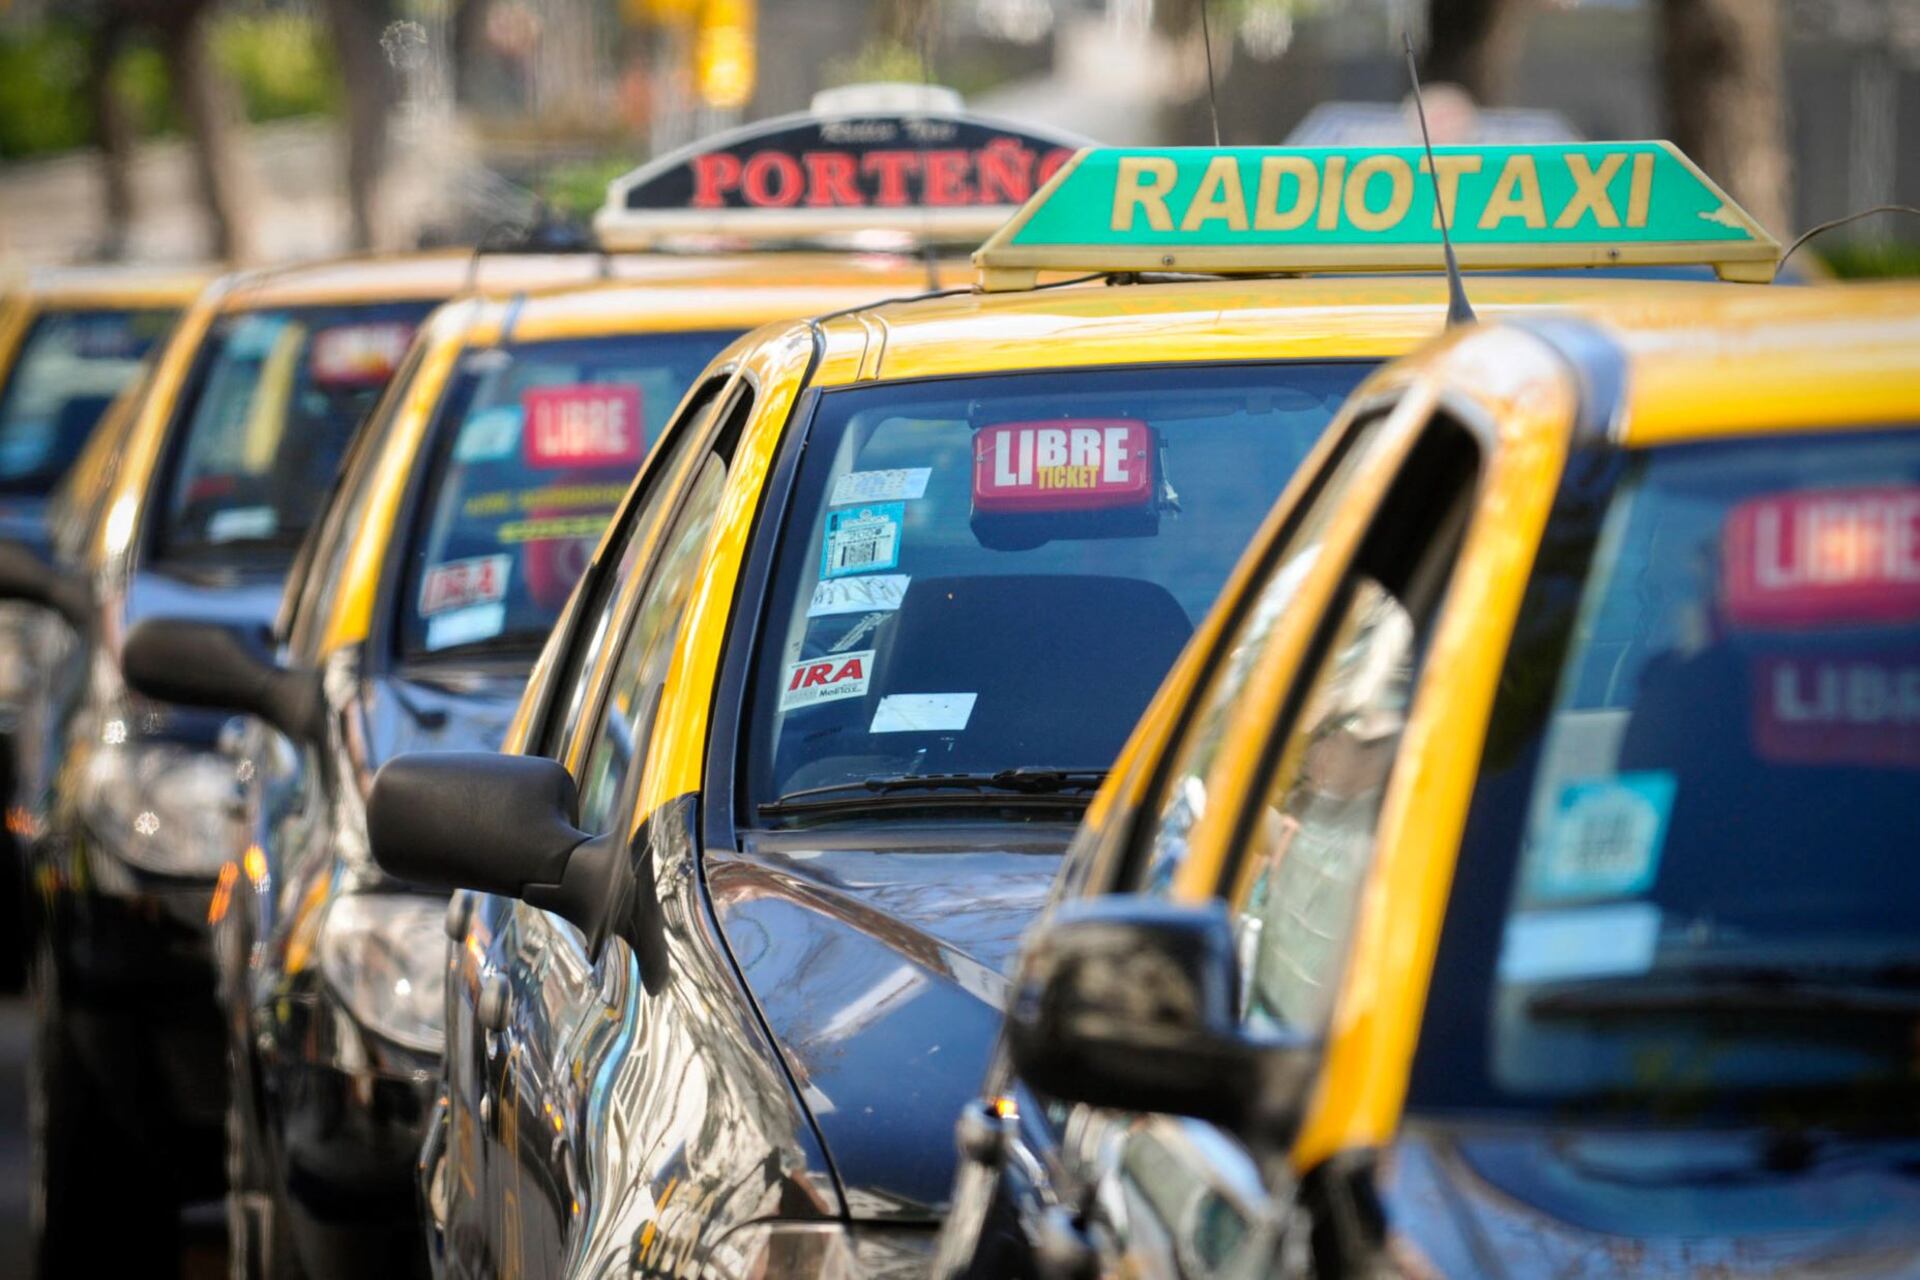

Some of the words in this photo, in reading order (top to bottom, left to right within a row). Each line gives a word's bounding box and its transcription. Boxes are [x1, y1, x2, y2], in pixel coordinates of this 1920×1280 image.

[1110, 153, 1655, 231] RADIOTAXI
[994, 427, 1130, 487] LIBRE
[1037, 464, 1099, 490] TICKET
[788, 658, 864, 691] IRA
